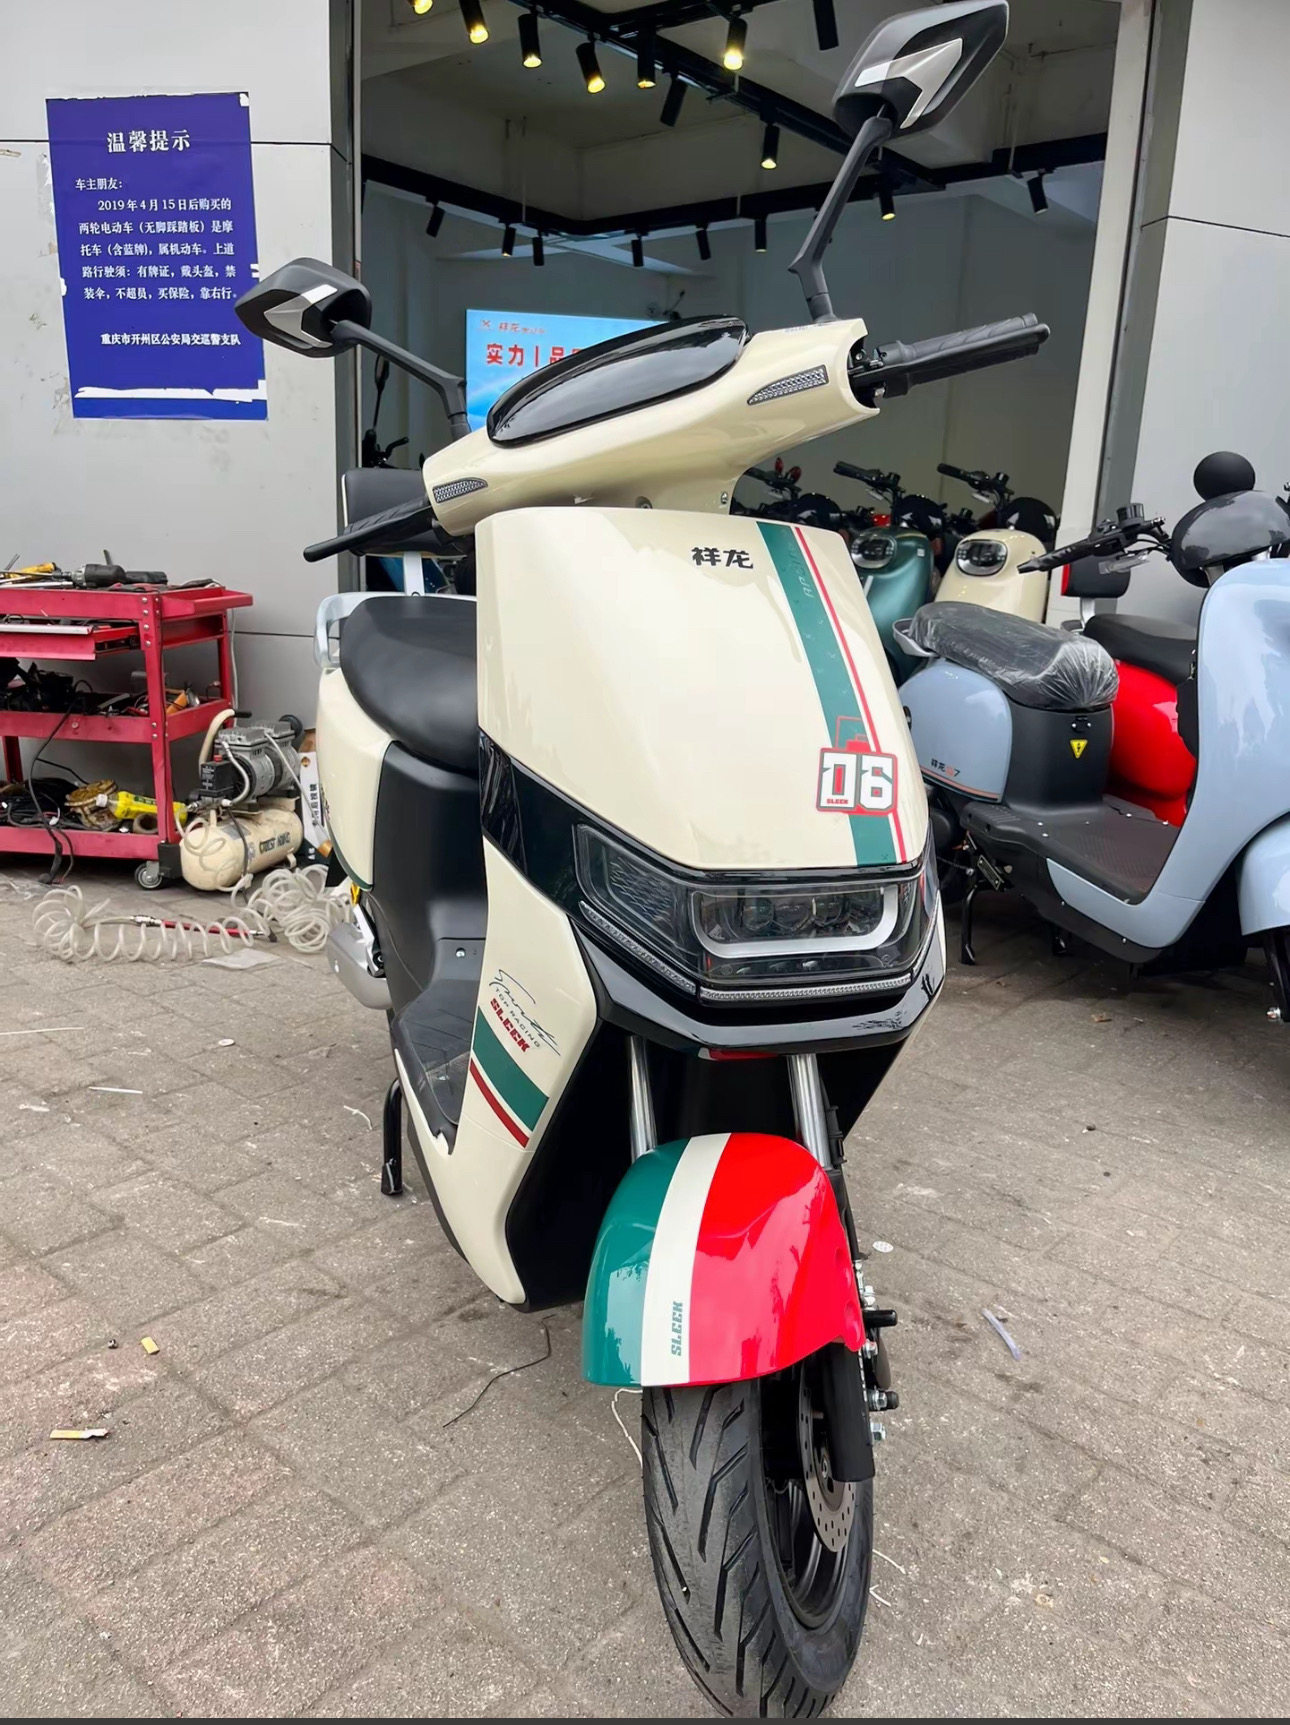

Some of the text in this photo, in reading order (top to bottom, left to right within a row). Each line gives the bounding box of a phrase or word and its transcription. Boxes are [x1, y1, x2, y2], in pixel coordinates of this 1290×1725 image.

[106, 129, 190, 153] 温馨提示
[100, 332, 241, 346] 重庆市开州区公安局交巡警支队
[691, 547, 753, 569] 祥龙
[820, 752, 893, 809] 06
[490, 997, 530, 1053] SLEEK
[495, 987, 541, 1049] TOP RACING
[671, 1300, 683, 1357] SLEEK
